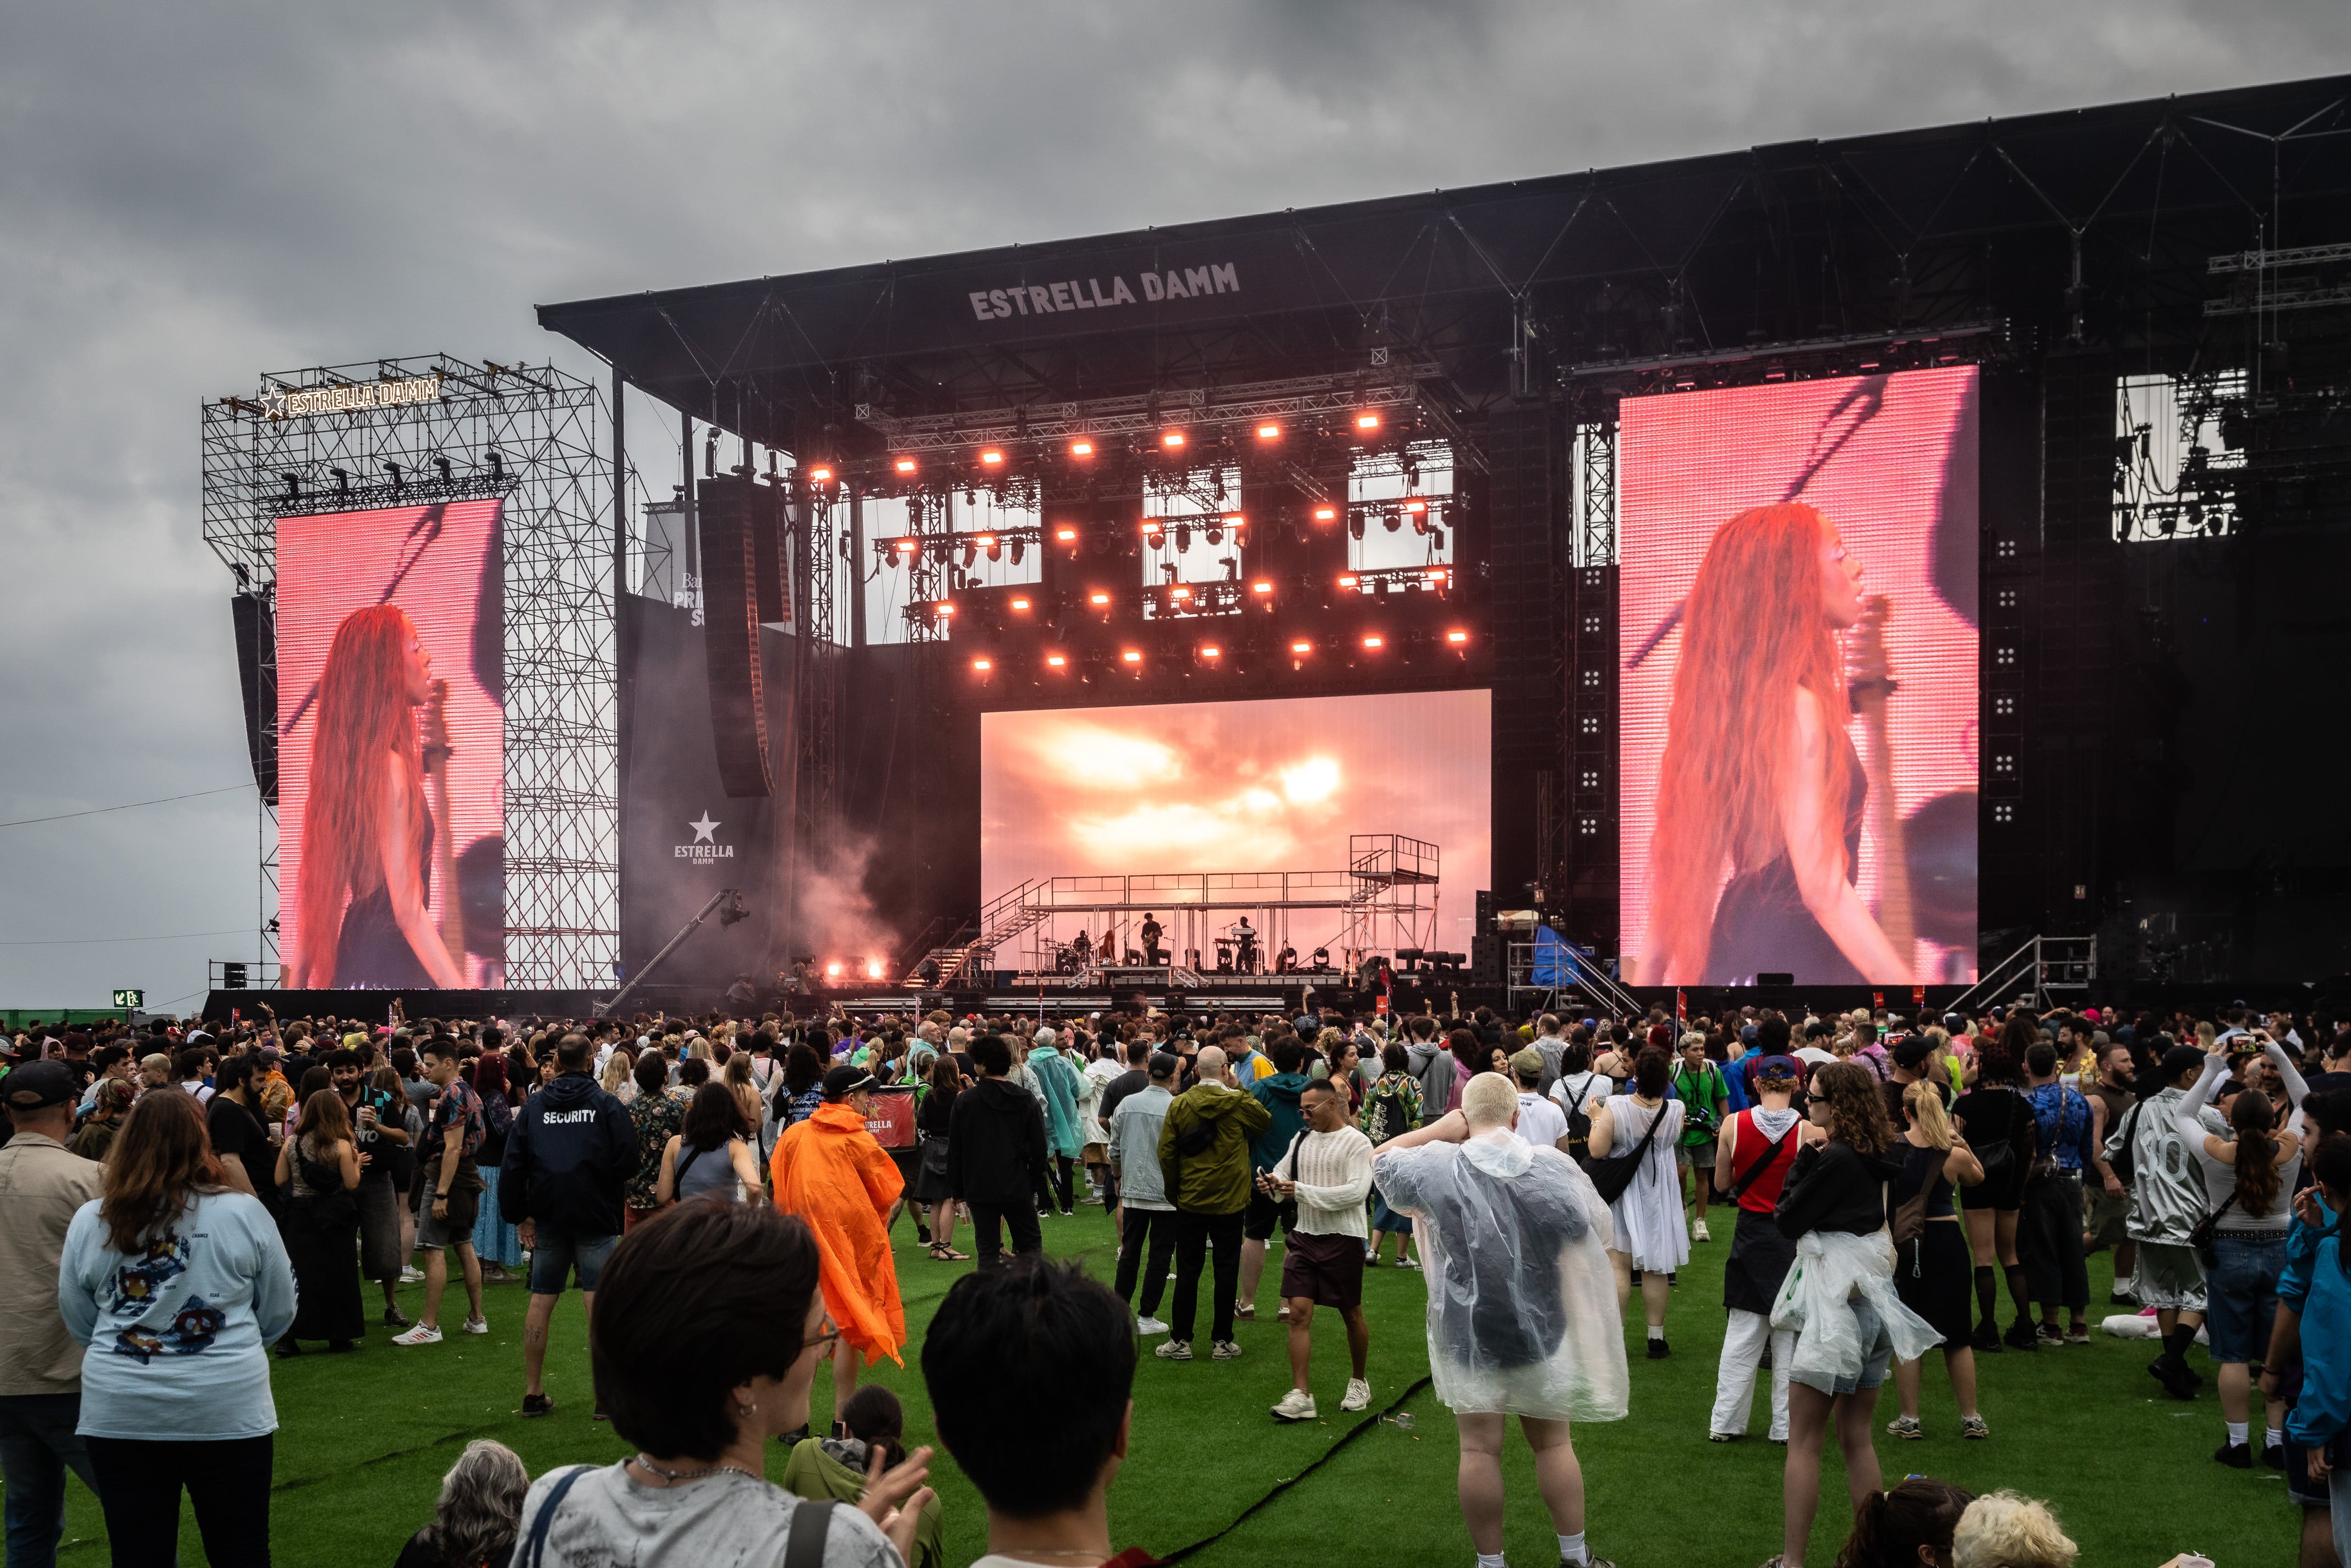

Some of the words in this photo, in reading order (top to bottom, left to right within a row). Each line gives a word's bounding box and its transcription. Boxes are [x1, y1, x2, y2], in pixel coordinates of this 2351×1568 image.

[969, 275, 1136, 320] ESTRELLA
[1140, 263, 1239, 302] DAMM
[288, 386, 375, 414] ESTRELLA
[379, 379, 438, 405] DAMM
[674, 845, 734, 857] ESTRELLA
[543, 1110, 596, 1124] SECURITY
